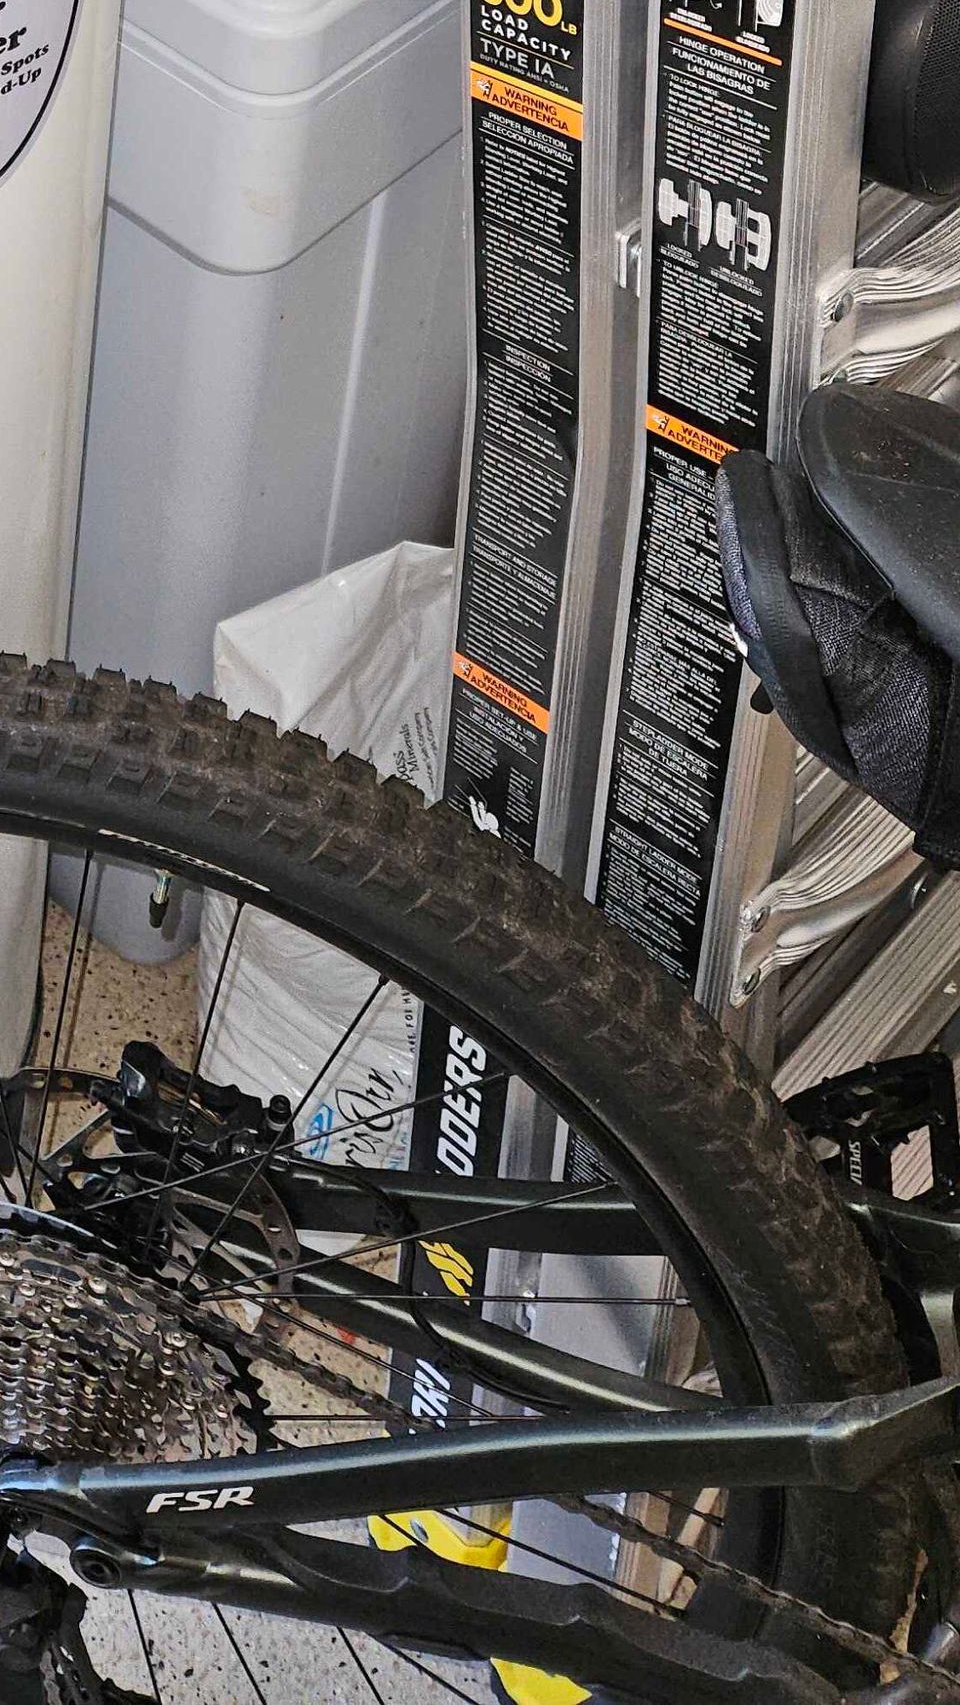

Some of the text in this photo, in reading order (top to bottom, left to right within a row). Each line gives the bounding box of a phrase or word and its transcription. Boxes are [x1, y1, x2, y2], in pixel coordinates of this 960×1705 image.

[481, 5, 528, 31] LOAD
[561, 21, 577, 35] LB
[481, 19, 571, 61] CAPACITY
[679, 36, 709, 54] HINGE
[709, 47, 765, 74] OPERATION
[1, 45, 49, 76] Spots
[480, 37, 555, 79] TYPE IA
[480, 53, 498, 65] DUTY
[499, 60, 525, 77] RATING
[549, 80, 569, 94] OSHA
[672, 47, 771, 91] FUNCIONAMIENTO DE
[687, 64, 754, 95] LAS BISAGRAS
[492, 93, 569, 132] ADVERTENCIA
[504, 86, 557, 116] WARNING
[488, 112, 567, 150] PROPER SELECTION
[528, 139, 573, 164] APROPIADA
[506, 345, 550, 372] INSPECTION
[653, 446, 707, 478] PROPER USE
[474, 534, 511, 559] TRANSPORT
[512, 556, 526, 568] AND
[470, 676, 536, 724] ADVERTENCIA
[482, 672, 527, 707] WARNING
[400, 723, 420, 773] Minerals
[629, 727, 708, 781] MODO DE ESCALERA
[633, 720, 709, 771] STEPLADDER MODE
[648, 748, 659, 758] DE
[609, 832, 630, 850] MODO
[615, 826, 697, 884] STRAIGHT LADDER MODE
[146, 1486, 255, 1513] FSR
